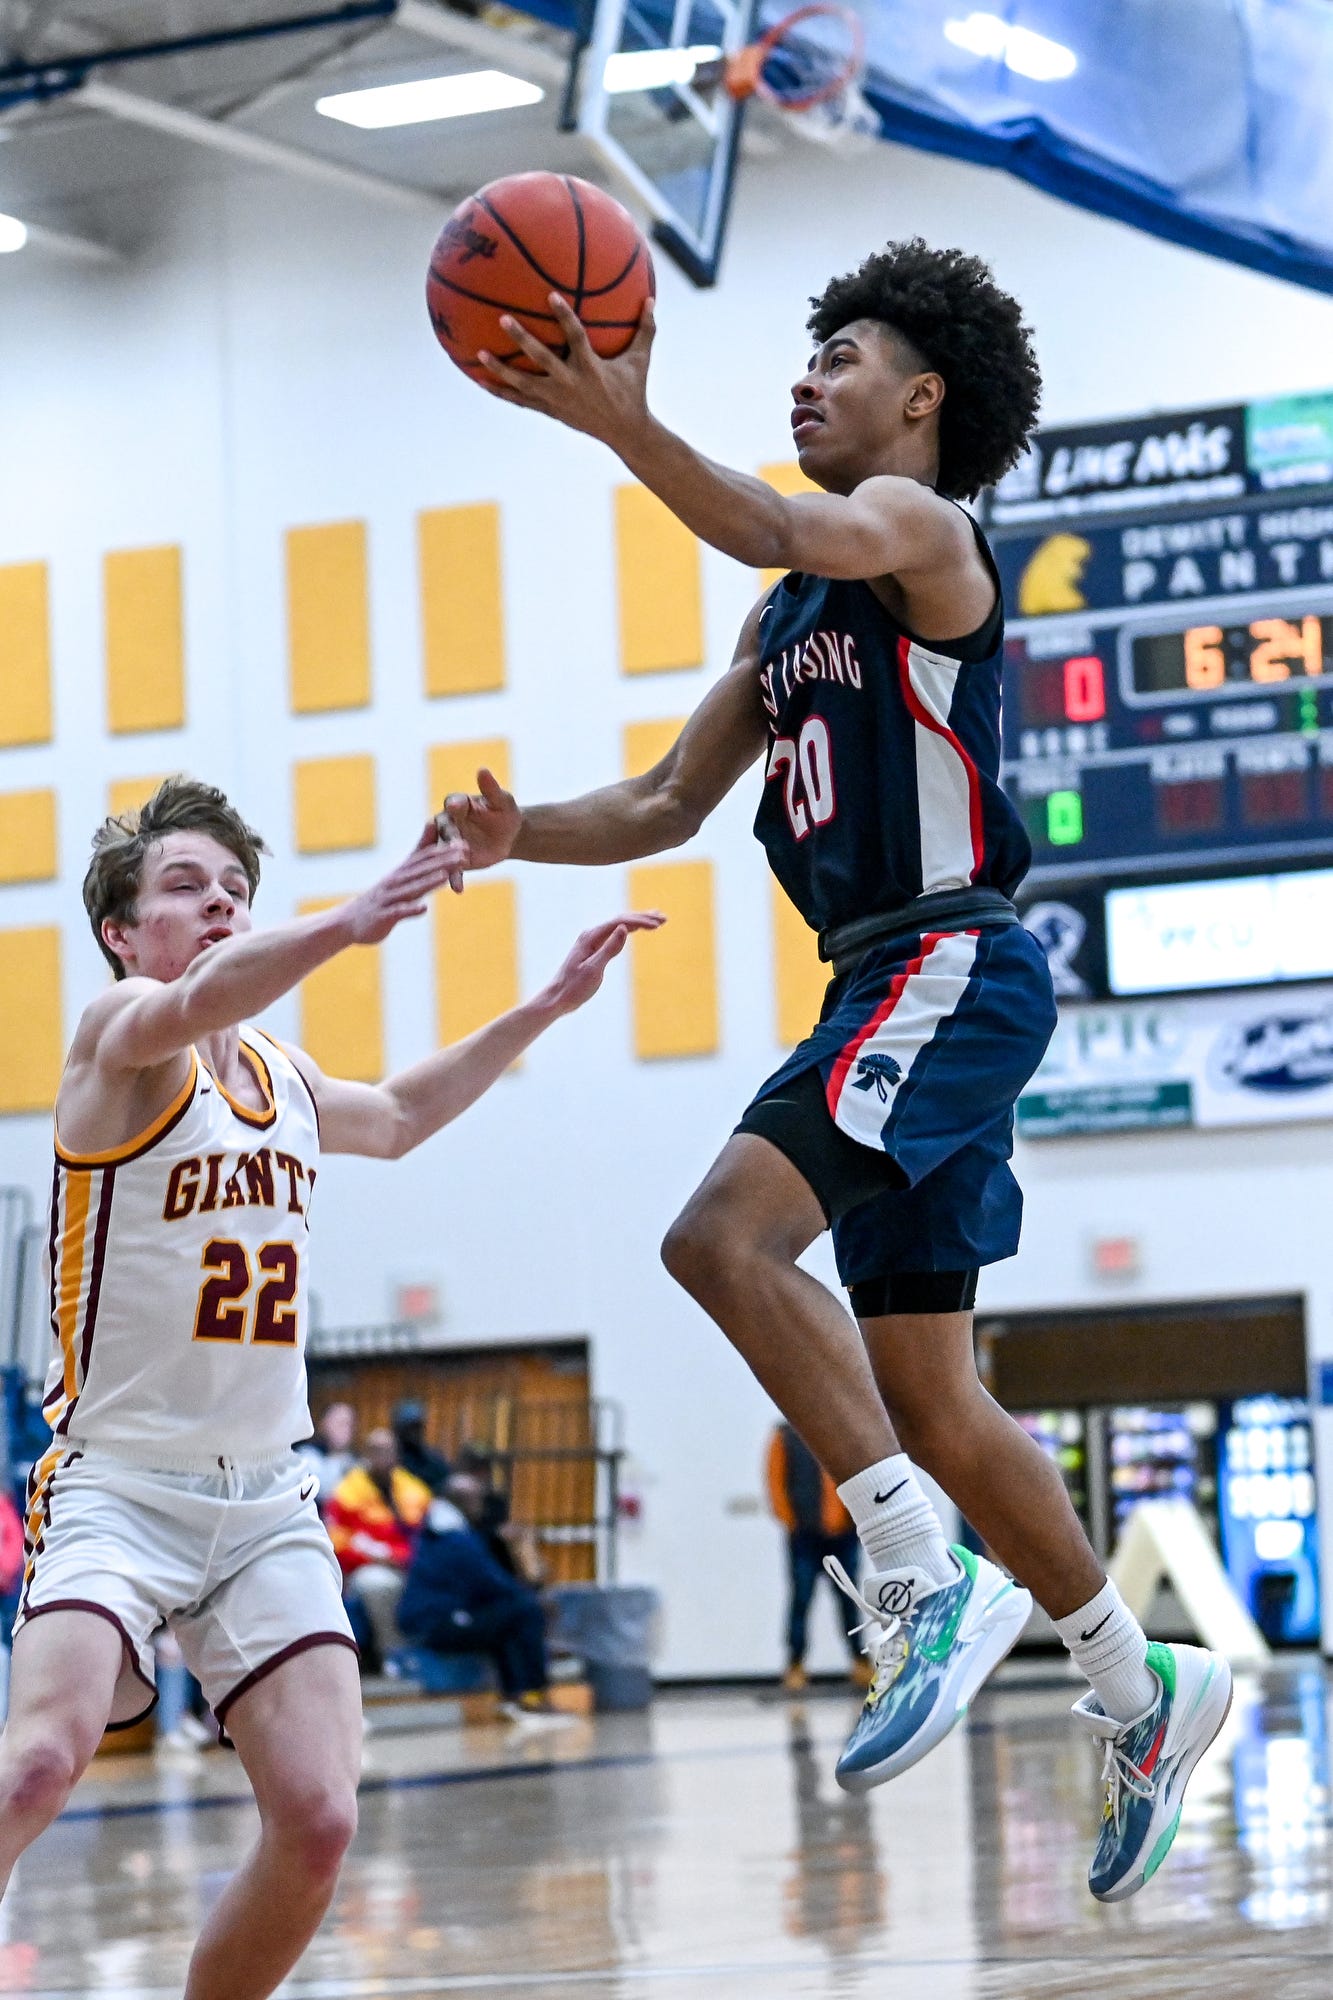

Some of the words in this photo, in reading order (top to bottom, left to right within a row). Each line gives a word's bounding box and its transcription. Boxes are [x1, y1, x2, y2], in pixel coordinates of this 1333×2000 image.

[1064, 656, 1105, 721] 0
[765, 713, 837, 843] 20
[1047, 790, 1083, 845] 0
[192, 1237, 299, 1348] 22
